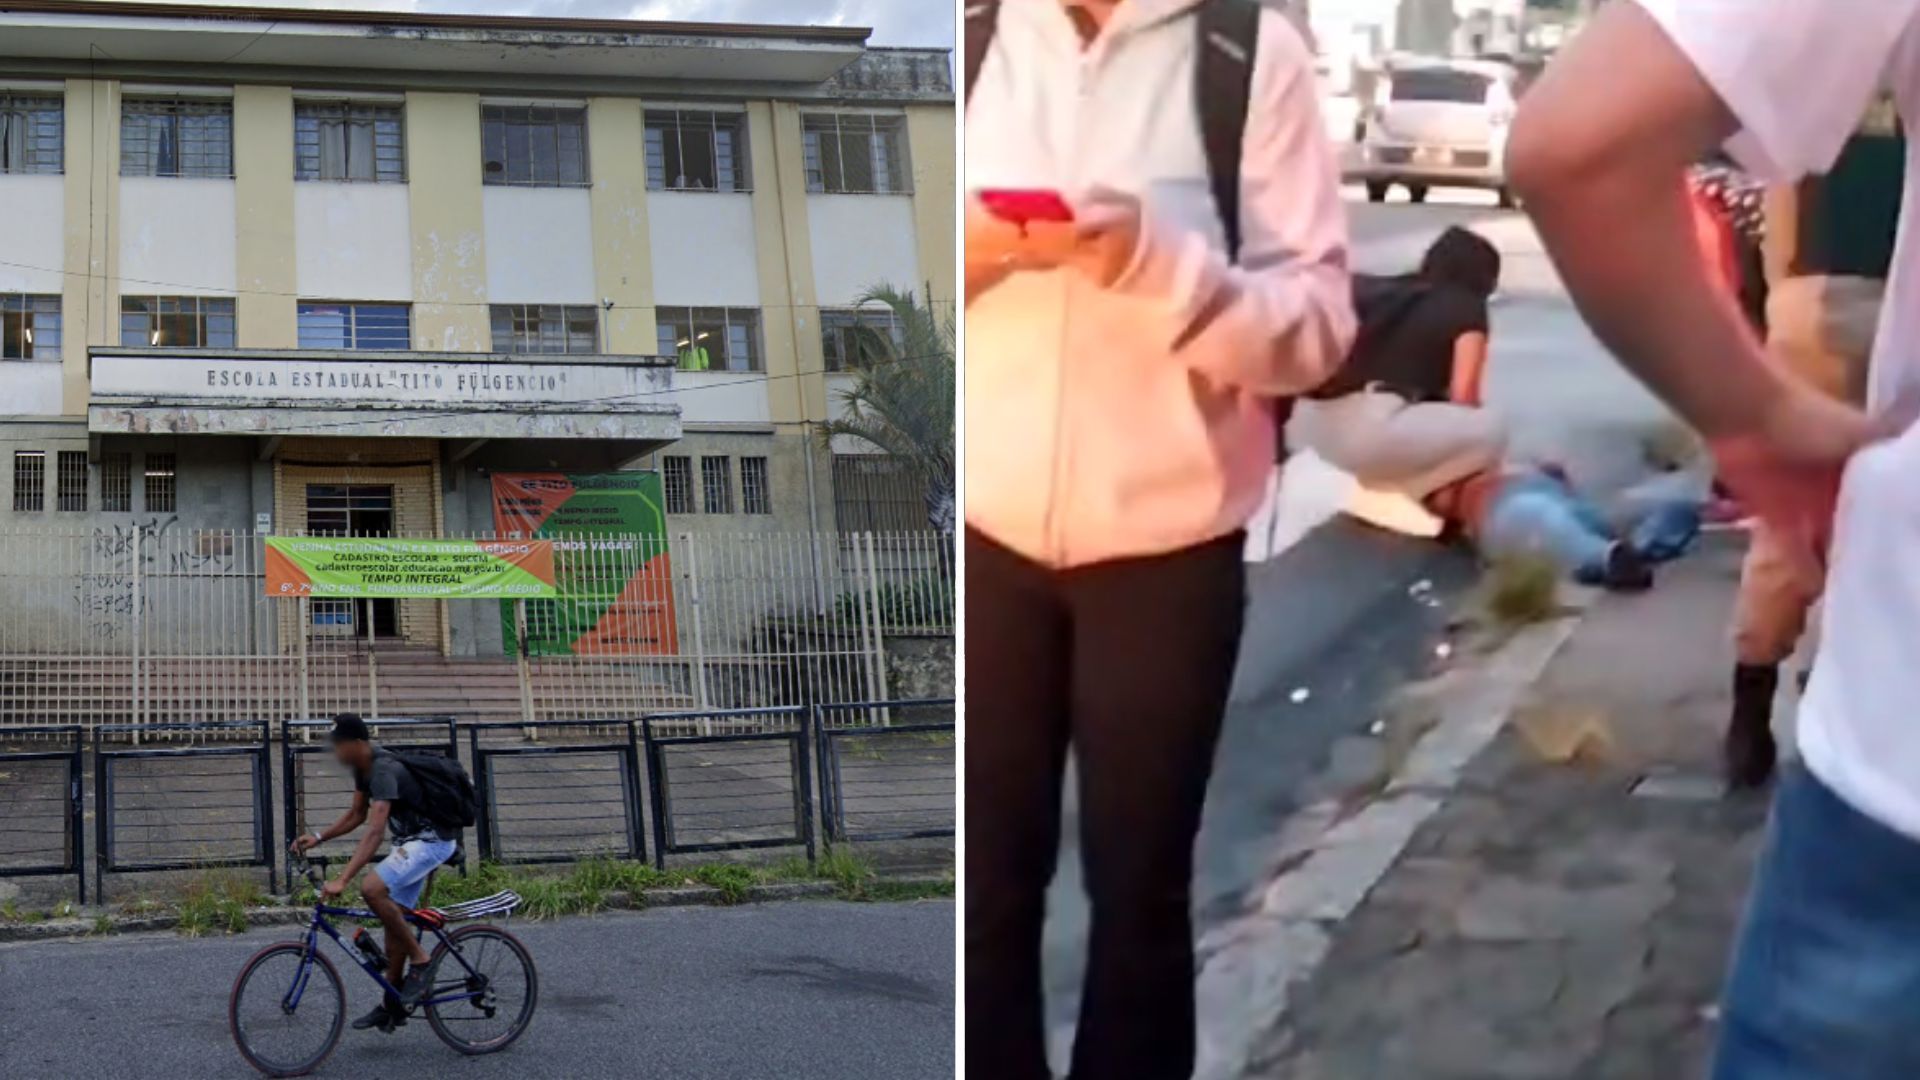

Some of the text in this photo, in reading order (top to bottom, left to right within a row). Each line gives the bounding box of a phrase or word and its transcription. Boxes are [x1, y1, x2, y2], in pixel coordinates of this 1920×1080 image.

[207, 370, 278, 387] ESCOLA
[292, 371, 384, 389] ESTADUAL
[553, 541, 588, 550] EMOS
[333, 553, 390, 562] CADASTRO
[392, 554, 439, 563] ESCOLAR
[361, 574, 463, 584] TEMPO INTEGRAL
